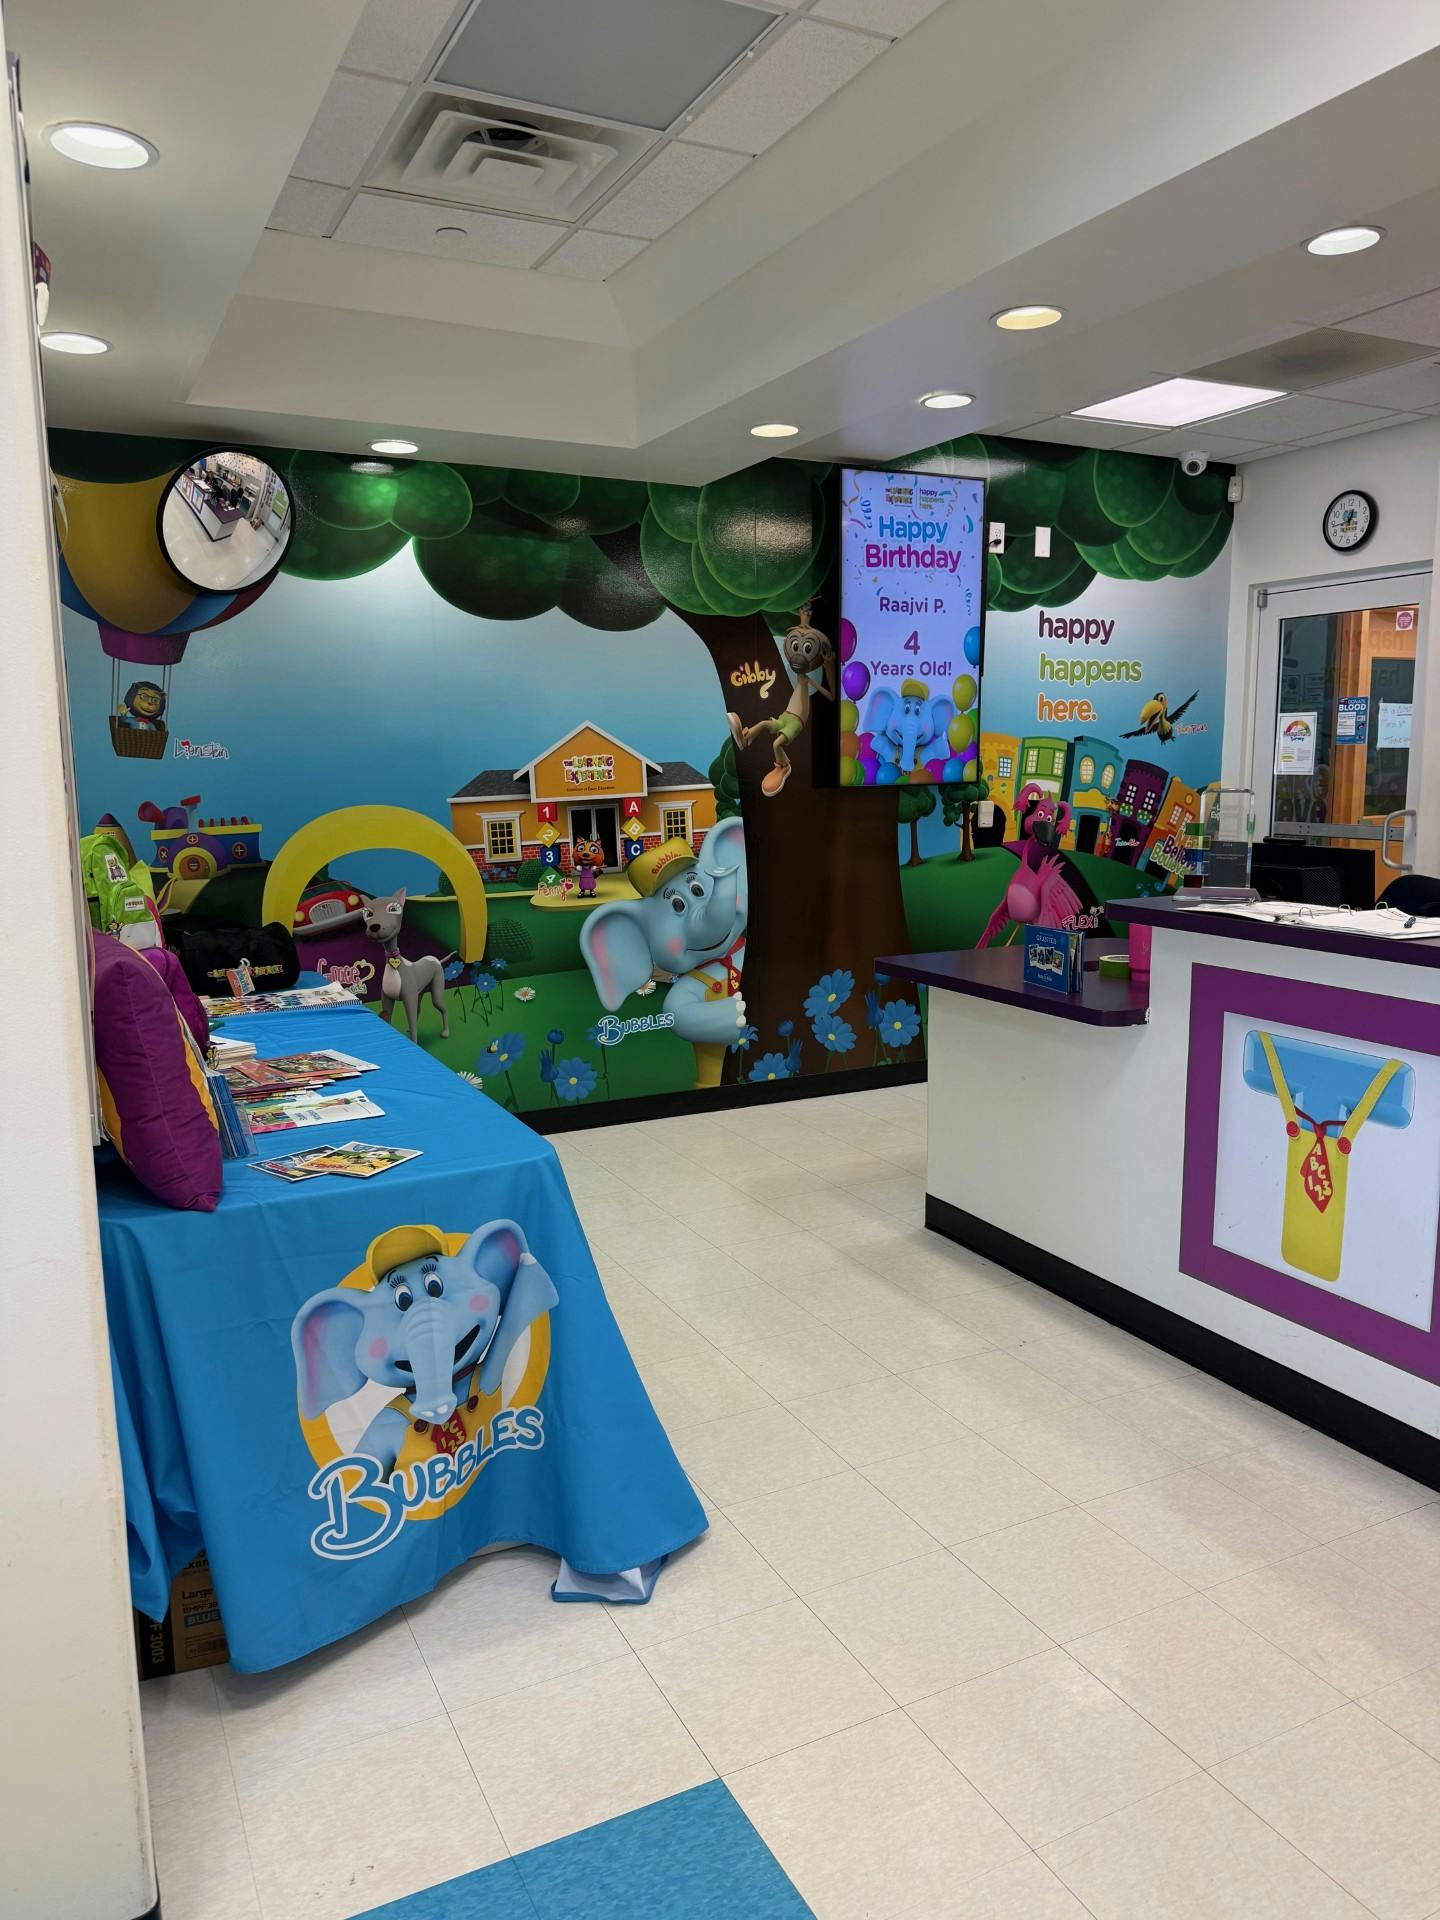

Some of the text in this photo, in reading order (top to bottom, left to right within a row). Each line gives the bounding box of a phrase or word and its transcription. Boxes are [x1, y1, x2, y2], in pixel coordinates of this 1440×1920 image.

[878, 514, 948, 544] Happy
[865, 544, 962, 574] Birthday
[879, 596, 946, 615] Raajvi P.
[1038, 610, 1115, 645] happy
[903, 630, 920, 655] 4
[870, 660, 952, 677] Years Old!
[1039, 652, 1142, 686] happens
[730, 660, 776, 699] Gibby
[1037, 692, 1098, 722] here.
[1338, 703, 1367, 711] BLOOD
[542, 806, 550, 819] 1
[629, 801, 639, 813] A
[543, 829, 554, 841] 2
[629, 823, 640, 835] B
[545, 850, 554, 863] 3
[631, 844, 641, 856] C
[546, 874, 556, 884] 4
[730, 969, 738, 979] A
[1312, 1144, 1321, 1155] A
[1310, 1157, 1319, 1171] B
[1317, 1165, 1326, 1179] C
[1308, 1176, 1313, 1190] 1
[1322, 1180, 1332, 1196] 3
[1314, 1185, 1325, 1201] 2
[182, 1588, 214, 1600] Large
[187, 1611, 219, 1625] BLUE
